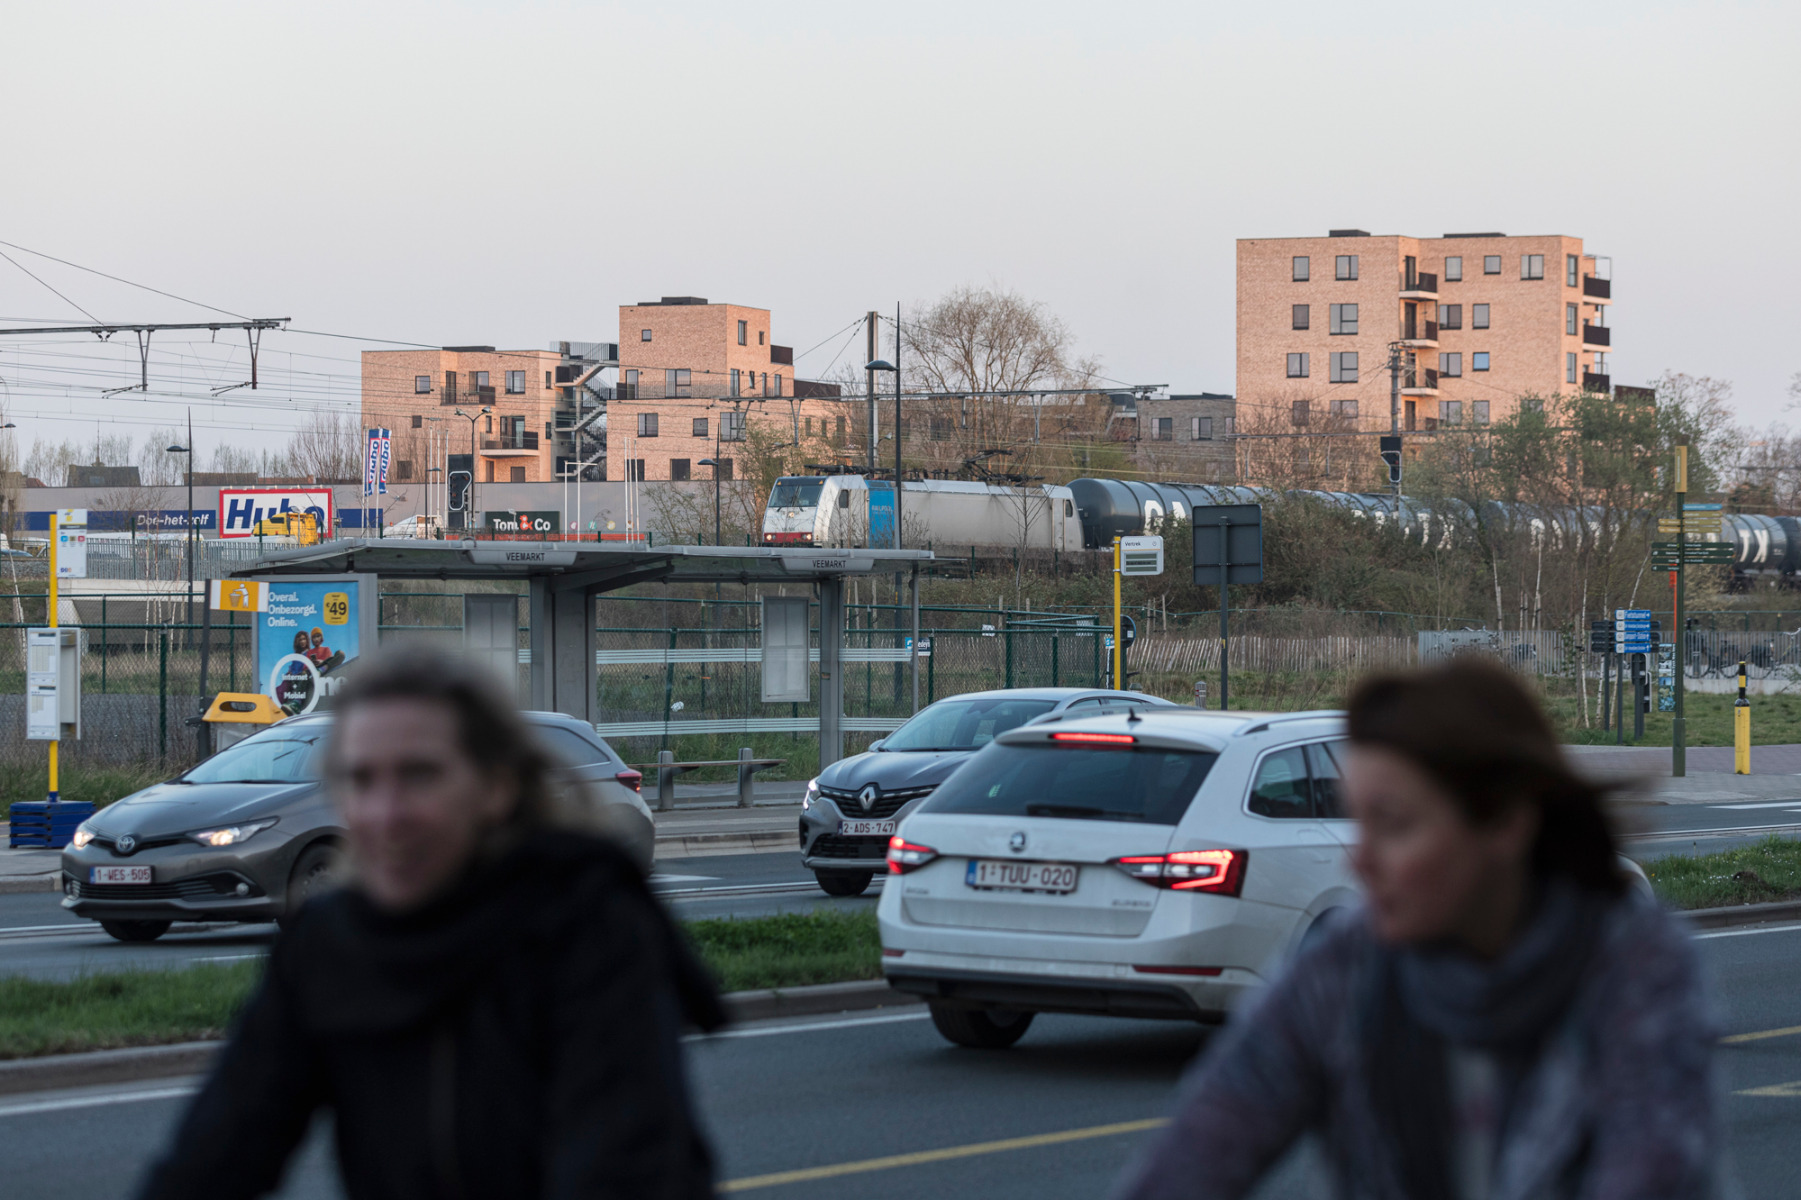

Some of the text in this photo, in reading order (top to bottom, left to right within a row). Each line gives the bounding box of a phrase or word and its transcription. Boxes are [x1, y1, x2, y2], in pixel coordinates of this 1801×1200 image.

[493, 518, 519, 531] Tom
[534, 518, 551, 531] Co
[506, 552, 546, 561] VEEMARKT
[812, 560, 846, 569] VEEMARKT
[268, 592, 299, 602] Overal.
[268, 604, 317, 617] Onbezorgd.
[267, 617, 298, 627] Online.
[281, 673, 308, 681] Internet
[283, 691, 306, 699] Mobiel
